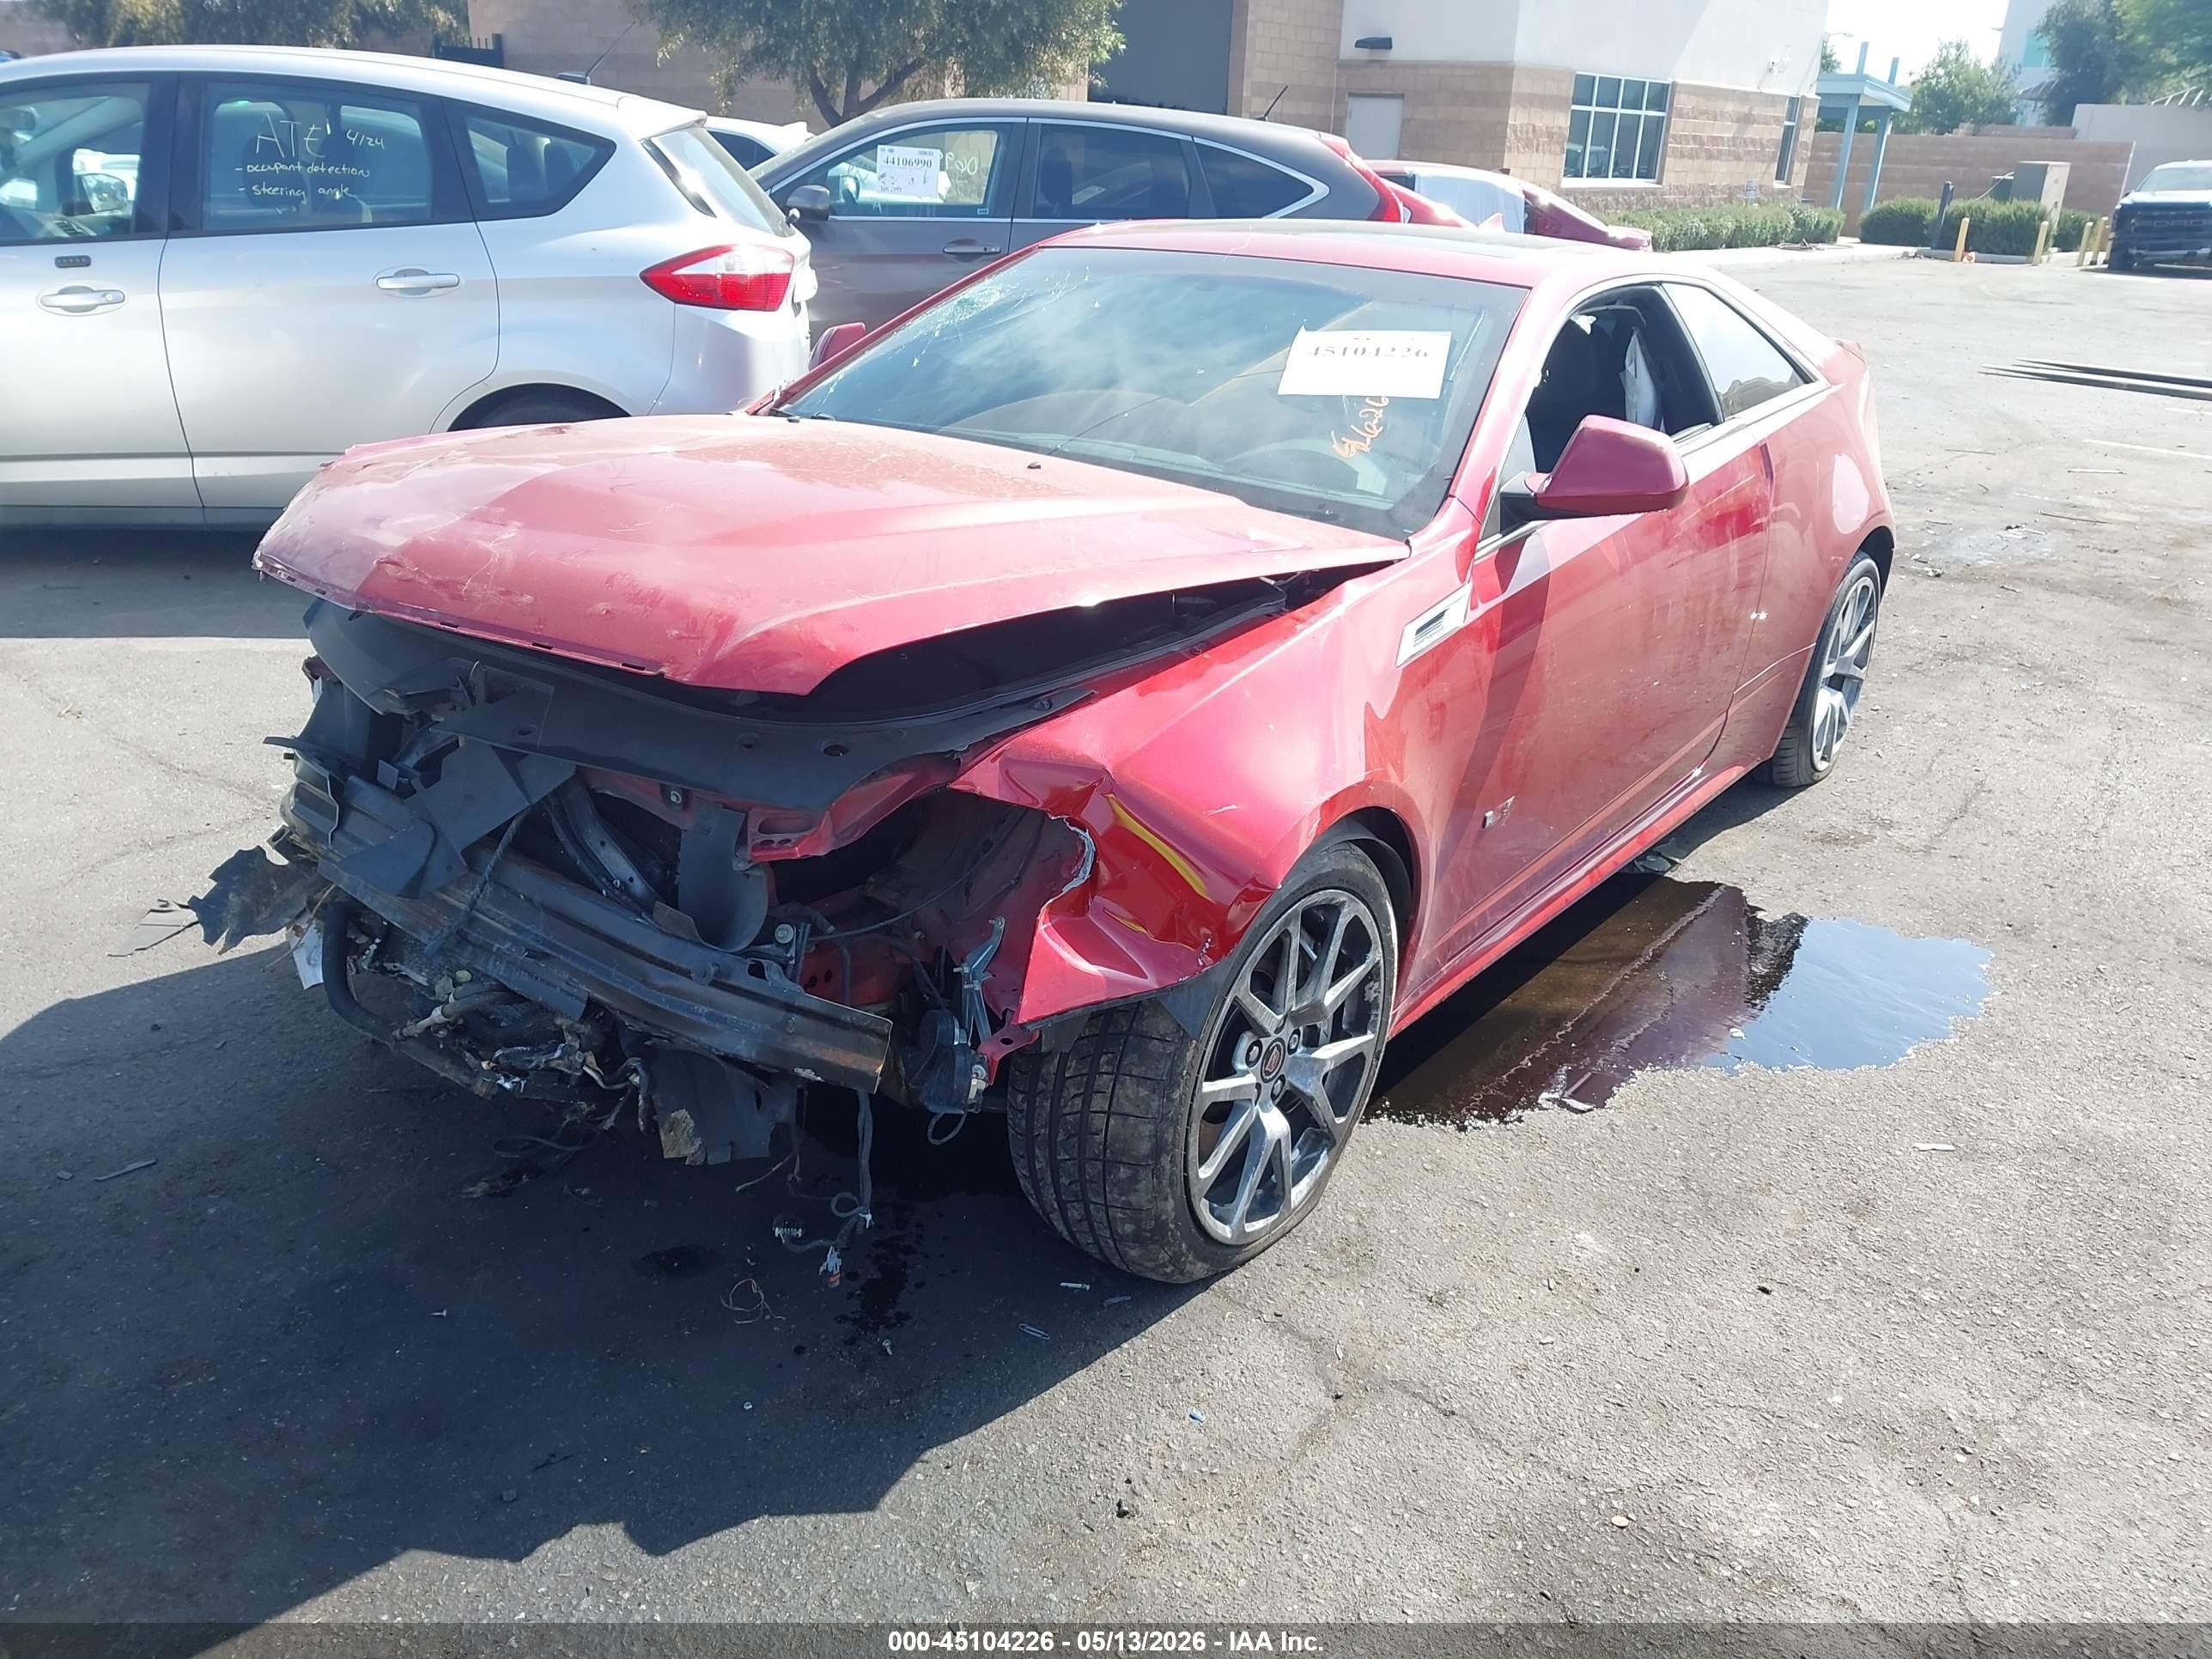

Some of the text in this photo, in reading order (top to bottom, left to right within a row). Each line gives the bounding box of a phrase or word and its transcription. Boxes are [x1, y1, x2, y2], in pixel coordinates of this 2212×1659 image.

[255, 112, 325, 158] ATE
[346, 129, 385, 149] 4/24
[246, 161, 301, 174] occupant
[883, 155, 933, 168] 44106990
[252, 181, 307, 205] steering
[318, 183, 349, 200] angle
[1306, 346, 1429, 358] 45104226
